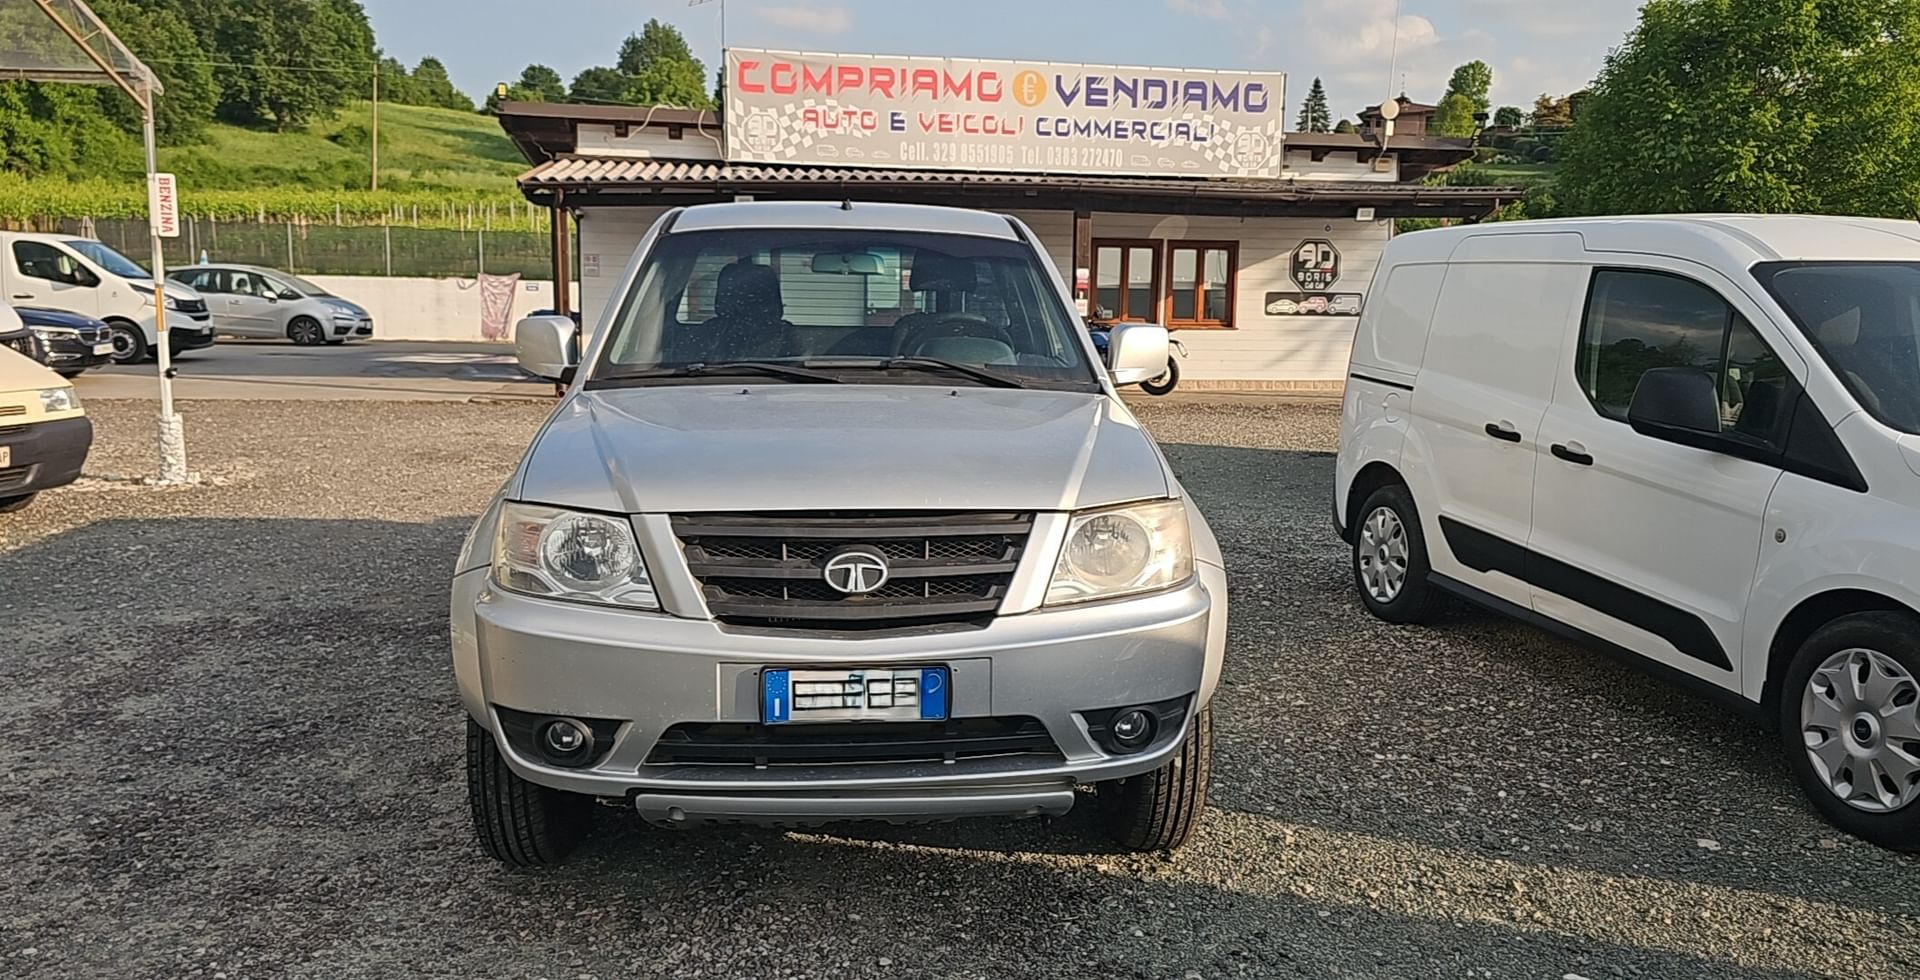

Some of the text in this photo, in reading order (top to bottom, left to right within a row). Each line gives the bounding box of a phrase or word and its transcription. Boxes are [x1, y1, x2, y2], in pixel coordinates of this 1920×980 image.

[738, 61, 1002, 103] COMPRIAMO
[1055, 73, 1269, 112] VENDIAMO
[803, 109, 1214, 142] AUTO E VEICOLI COMMERCIALI
[900, 141, 929, 161] Cell.
[932, 142, 956, 162] 329
[1021, 146, 1043, 165] Tel.
[1047, 146, 1078, 166] 0383
[1081, 147, 1123, 168] 272470
[159, 177, 173, 233] BENZINA
[1298, 272, 1332, 281] BORIS
